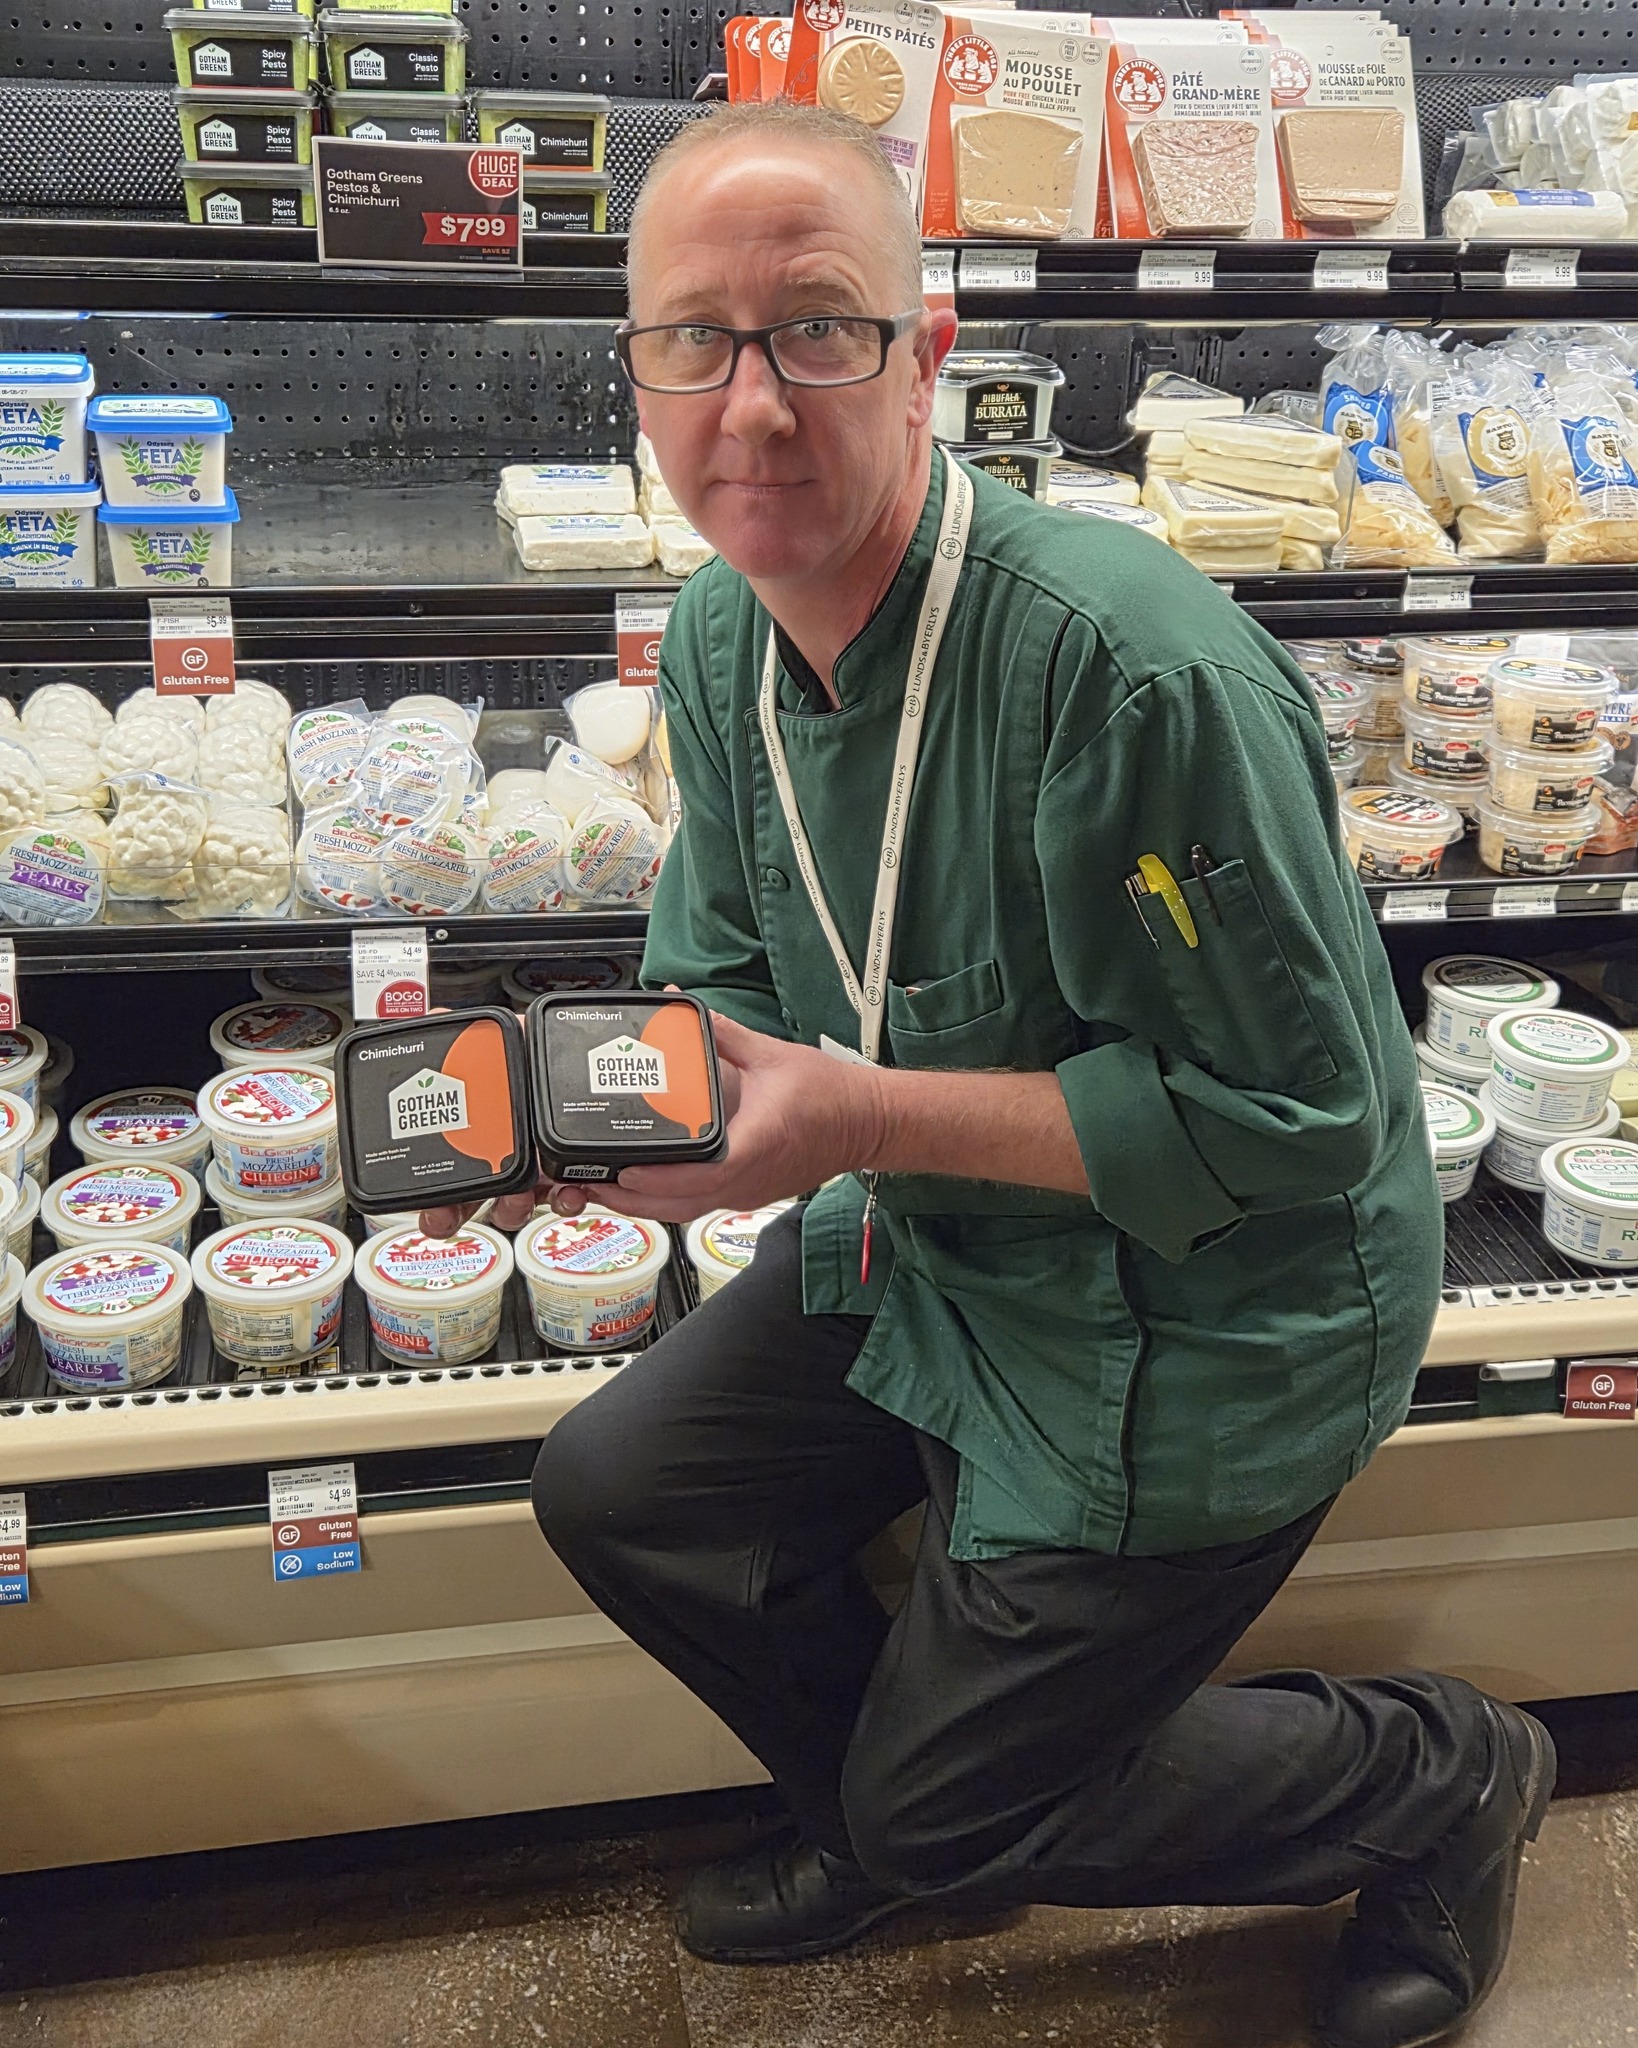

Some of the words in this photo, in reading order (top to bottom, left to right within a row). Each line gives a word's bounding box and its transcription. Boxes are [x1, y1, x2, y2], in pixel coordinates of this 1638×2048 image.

[845, 17, 892, 39] PETITS
[894, 27, 936, 50] PÂTÉS
[199, 55, 227, 63] GOTHAM
[262, 49, 286, 60] Spicy
[408, 52, 439, 62] Classic
[200, 63, 228, 72] GREENS
[262, 60, 287, 69] Pesto
[354, 60, 382, 68] GOTHAM
[415, 63, 439, 72] Pesto
[1318, 63, 1356, 74] MOUSSE
[1357, 66, 1366, 74] DE
[1366, 63, 1386, 74] FOIE
[354, 68, 382, 77] GREENS
[1005, 59, 1073, 81] MOUSSE
[1172, 71, 1203, 87] PÂTÉ
[1319, 78, 1328, 86] DE
[1328, 75, 1365, 87] CANARD
[1366, 79, 1375, 87] AU
[1376, 75, 1406, 87] PORTO
[1003, 77, 1019, 89] AU
[1021, 77, 1082, 97] POULET
[1172, 85, 1261, 100] GRAND-MÈRE
[1003, 90, 1017, 98] PORK
[1018, 91, 1031, 100] FREE
[1032, 94, 1054, 103] CHICKEN
[1055, 97, 1070, 105] LIVER
[1003, 97, 1023, 107] MOUSSE
[1024, 100, 1038, 108] WITH
[1039, 102, 1056, 111] BLACK
[1057, 104, 1076, 113] PEPPER
[205, 131, 232, 139] GOTHAM
[266, 125, 290, 135] Spicy
[410, 126, 440, 136] Classic
[205, 139, 233, 148] GREENS
[267, 135, 291, 144] Pesto
[505, 135, 531, 143] GOTHAM
[540, 137, 588, 147] Chimichurri
[478, 155, 517, 174] HUGE
[326, 168, 376, 182] Gotham
[378, 171, 423, 184] Greens
[327, 181, 369, 194] Pestos
[371, 183, 381, 194] &
[482, 177, 514, 188] DEAL
[272, 198, 295, 208] Spicy
[328, 193, 400, 207] Chimichurri
[210, 204, 238, 212] GOTHAM
[272, 208, 296, 216] Pesto
[329, 206, 339, 214] 6.5
[211, 212, 238, 220] GREENS
[541, 211, 588, 221] Chimichurri
[1014, 270, 1031, 282] 9.99
[1194, 271, 1211, 283] 9.99
[1366, 270, 1384, 282] 9.99
[1555, 266, 1571, 278] 9.99
[975, 405, 1027, 419] BURRATA
[138, 449, 187, 464] FETA
[147, 474, 182, 482] TRADITIONAL
[6, 516, 58, 532] FETA
[42, 544, 60, 552] BRINE
[148, 539, 195, 553] FETA
[156, 564, 190, 572] TRADITIONAL
[1450, 591, 1465, 602] 5.79
[206, 615, 227, 628] $5.99
[913, 606, 940, 692] LUNDS&BYERLYS
[186, 655, 203, 664] GF
[162, 676, 201, 685] Gluten
[204, 675, 230, 684] Free
[890, 765, 907, 845] LUNDS&BYERLYS
[392, 841, 418, 859] FRESH
[419, 851, 477, 877] MOZZARELLA
[509, 839, 560, 874] MOZZARELLA
[577, 868, 596, 890] FRESH
[595, 818, 632, 870] MOZZARELLA
[9, 846, 38, 862] FRESH
[40, 855, 99, 882] MOZZARELLA
[17, 864, 85, 895] PEARLS
[1428, 901, 1442, 911] 5.99
[1537, 897, 1551, 907] 5.99
[403, 946, 422, 957] $4.49
[872, 910, 886, 983] LUNDS&BYERLYS
[356, 970, 375, 979] SAVE
[385, 991, 423, 1001] BOGO
[556, 1011, 623, 1021] Chimichurri
[1517, 1024, 1603, 1046] RICOTTA
[358, 1041, 425, 1061] Chimichurri
[596, 1058, 658, 1072] GOTHAM
[598, 1072, 660, 1087] GREENS
[249, 1081, 295, 1117] CILIEGINE
[397, 1090, 459, 1114] GOTHAM
[115, 1118, 173, 1127] PEARLS
[399, 1107, 460, 1130] GREENS
[242, 1157, 317, 1172] MOZZARELLA
[266, 1156, 294, 1164] FRESH
[242, 1166, 318, 1182] CILIEGINE
[426, 1166, 453, 1175] Refrigerated
[77, 1182, 108, 1190] FRESH
[109, 1184, 174, 1195] MOZZARELLA
[90, 1192, 150, 1203] PEARLS
[557, 1225, 618, 1261] CILIEGINE
[227, 1244, 259, 1252] FRESH
[262, 1246, 328, 1255] MOZZARELLA
[394, 1248, 478, 1262] CILIEGINE
[231, 1254, 316, 1266] CILIEGINE
[457, 1257, 488, 1267] FRESH
[385, 1261, 454, 1272] MOZZARELLA
[77, 1270, 141, 1288] PEARLS
[134, 1276, 166, 1288] FRESH
[56, 1283, 131, 1302] MOZZARELLA
[58, 1344, 85, 1354] FRESH
[51, 1354, 104, 1375] PEARLS
[1595, 1382, 1611, 1391] GF
[1572, 1401, 1606, 1410] Gluten
[1609, 1401, 1631, 1411] Free
[277, 1495, 300, 1503] US-FD
[329, 1488, 351, 1502] $4.99
[319, 1521, 352, 1531] Gluten
[282, 1531, 297, 1540] GF
[331, 1532, 352, 1540] Free
[333, 1551, 354, 1559] Low
[317, 1560, 354, 1570] Sodium
